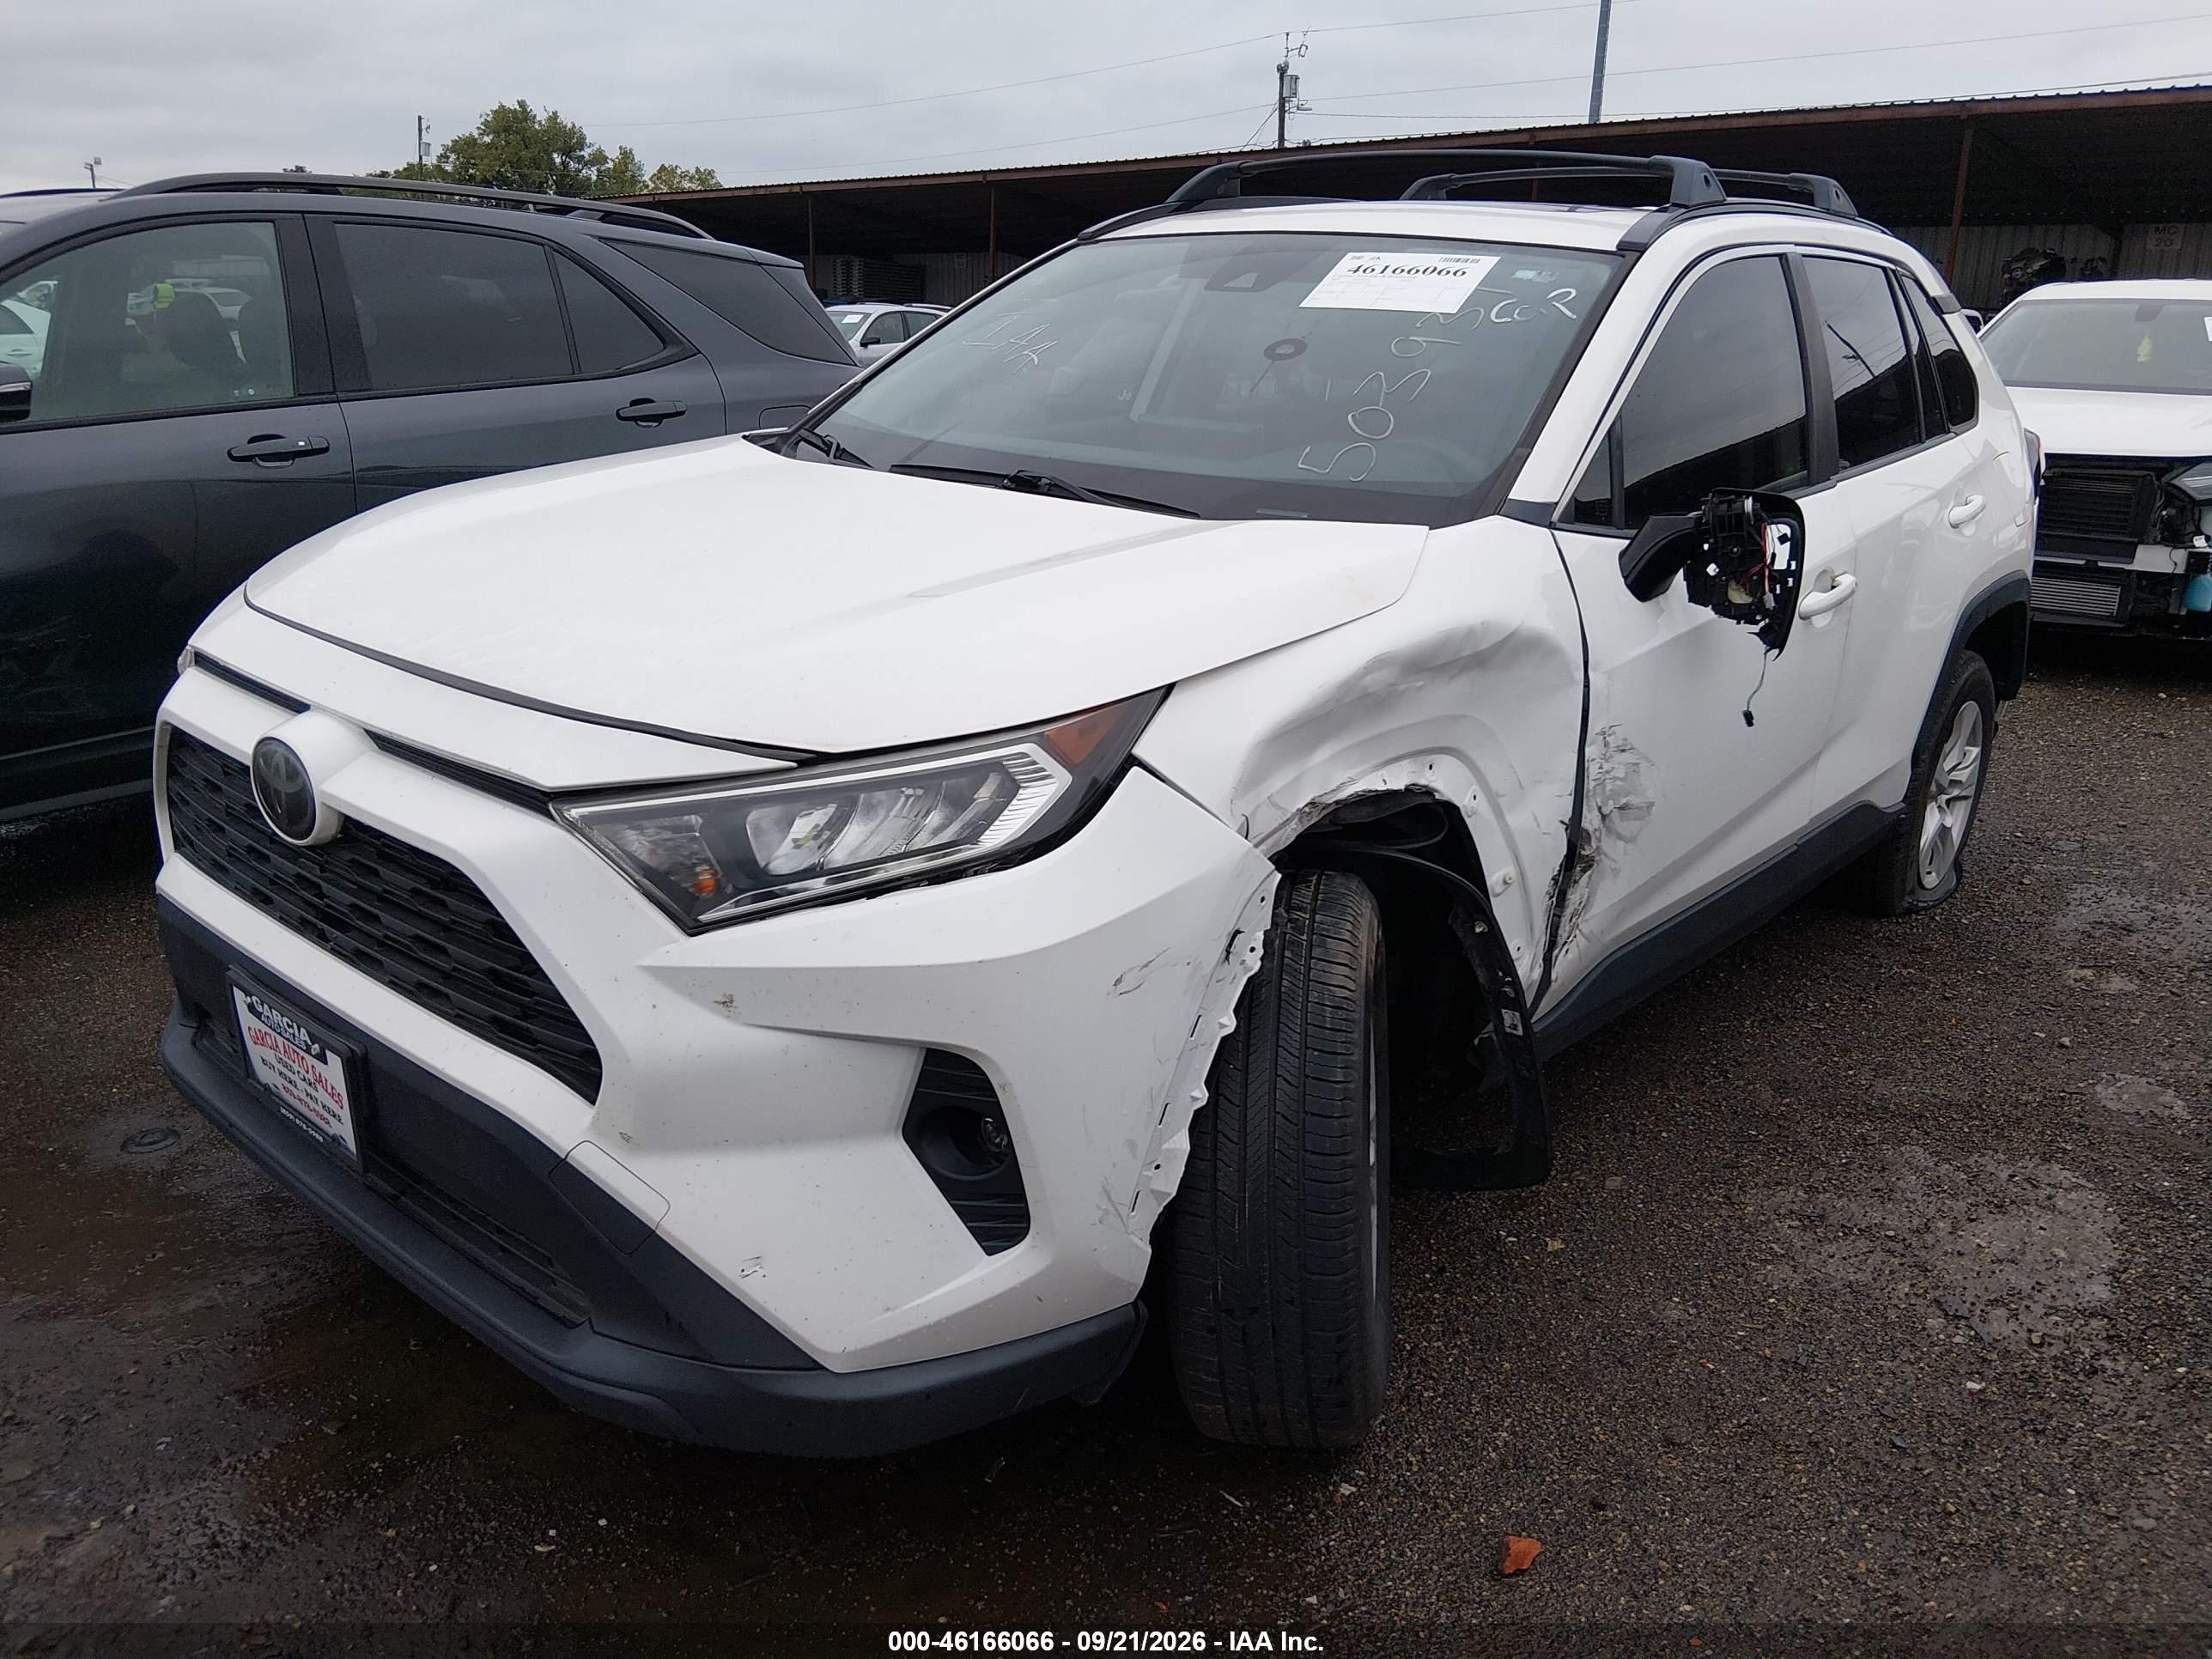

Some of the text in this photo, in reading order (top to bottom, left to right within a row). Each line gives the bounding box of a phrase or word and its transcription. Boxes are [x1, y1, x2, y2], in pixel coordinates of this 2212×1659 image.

[1347, 264, 1470, 277] 46166066
[252, 996, 312, 1045] GARCIA
[261, 1014, 307, 1050] AUTO SALES
[248, 1026, 282, 1055] GARCIA
[283, 1041, 310, 1075] AUTO
[311, 1065, 343, 1110] SALES
[275, 1054, 319, 1093] USED CARS
